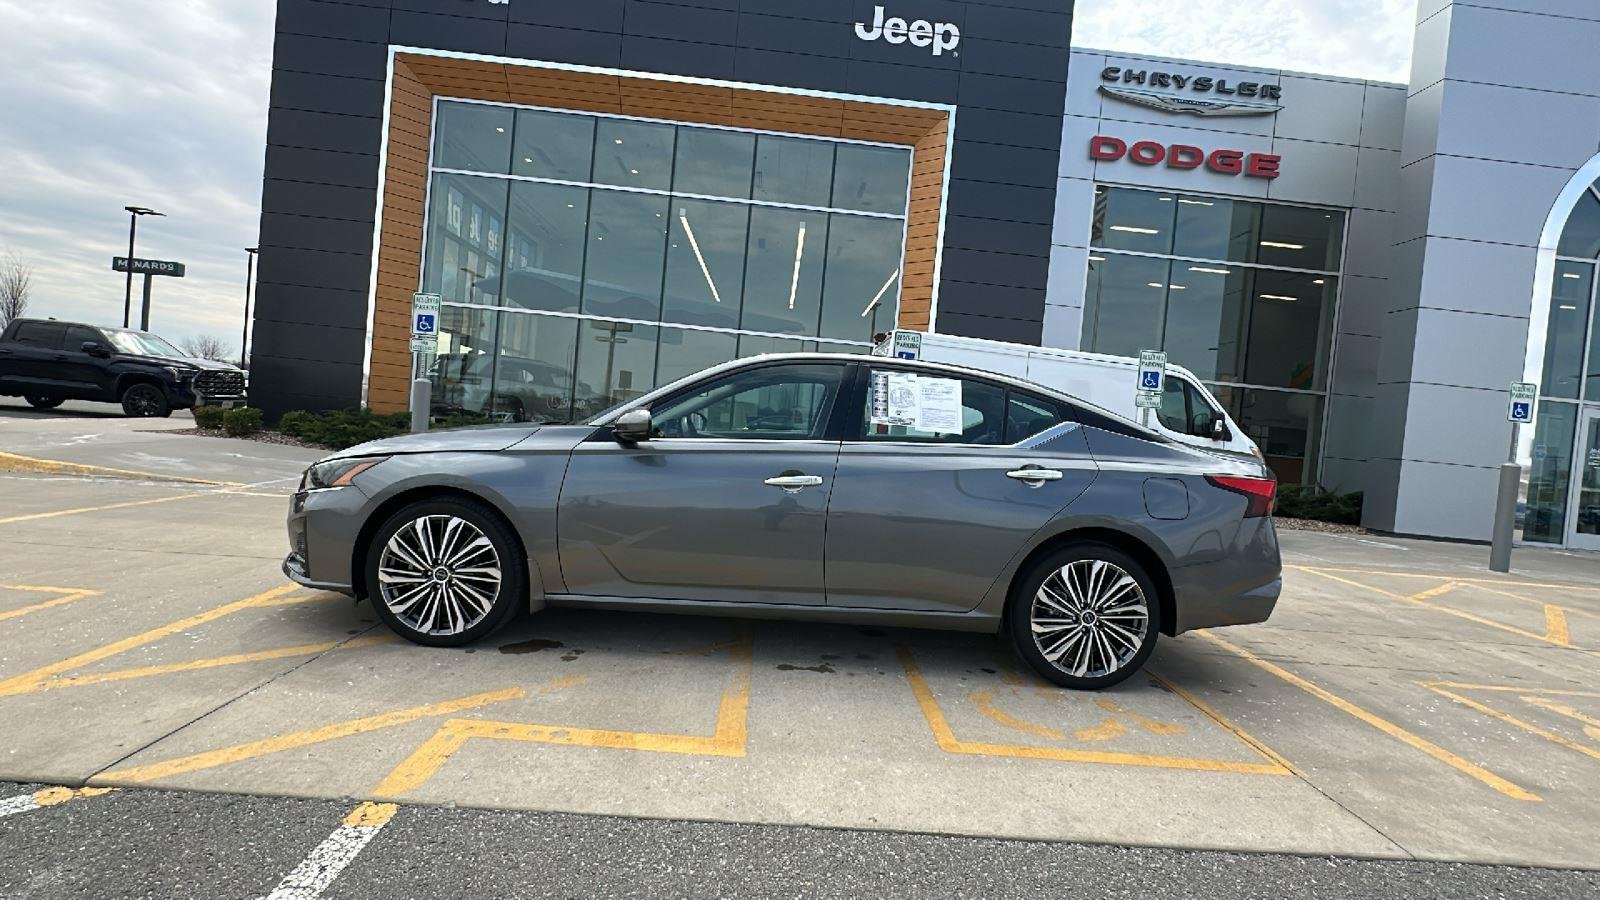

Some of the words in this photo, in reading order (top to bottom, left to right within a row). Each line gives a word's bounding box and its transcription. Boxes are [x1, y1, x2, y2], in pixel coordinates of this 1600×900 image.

[854, 5, 960, 56] Jeep
[1101, 66, 1282, 99] CHRYSLER
[1090, 135, 1281, 178] DODGE
[117, 259, 174, 271] MNARDS
[896, 341, 919, 349] PARKING
